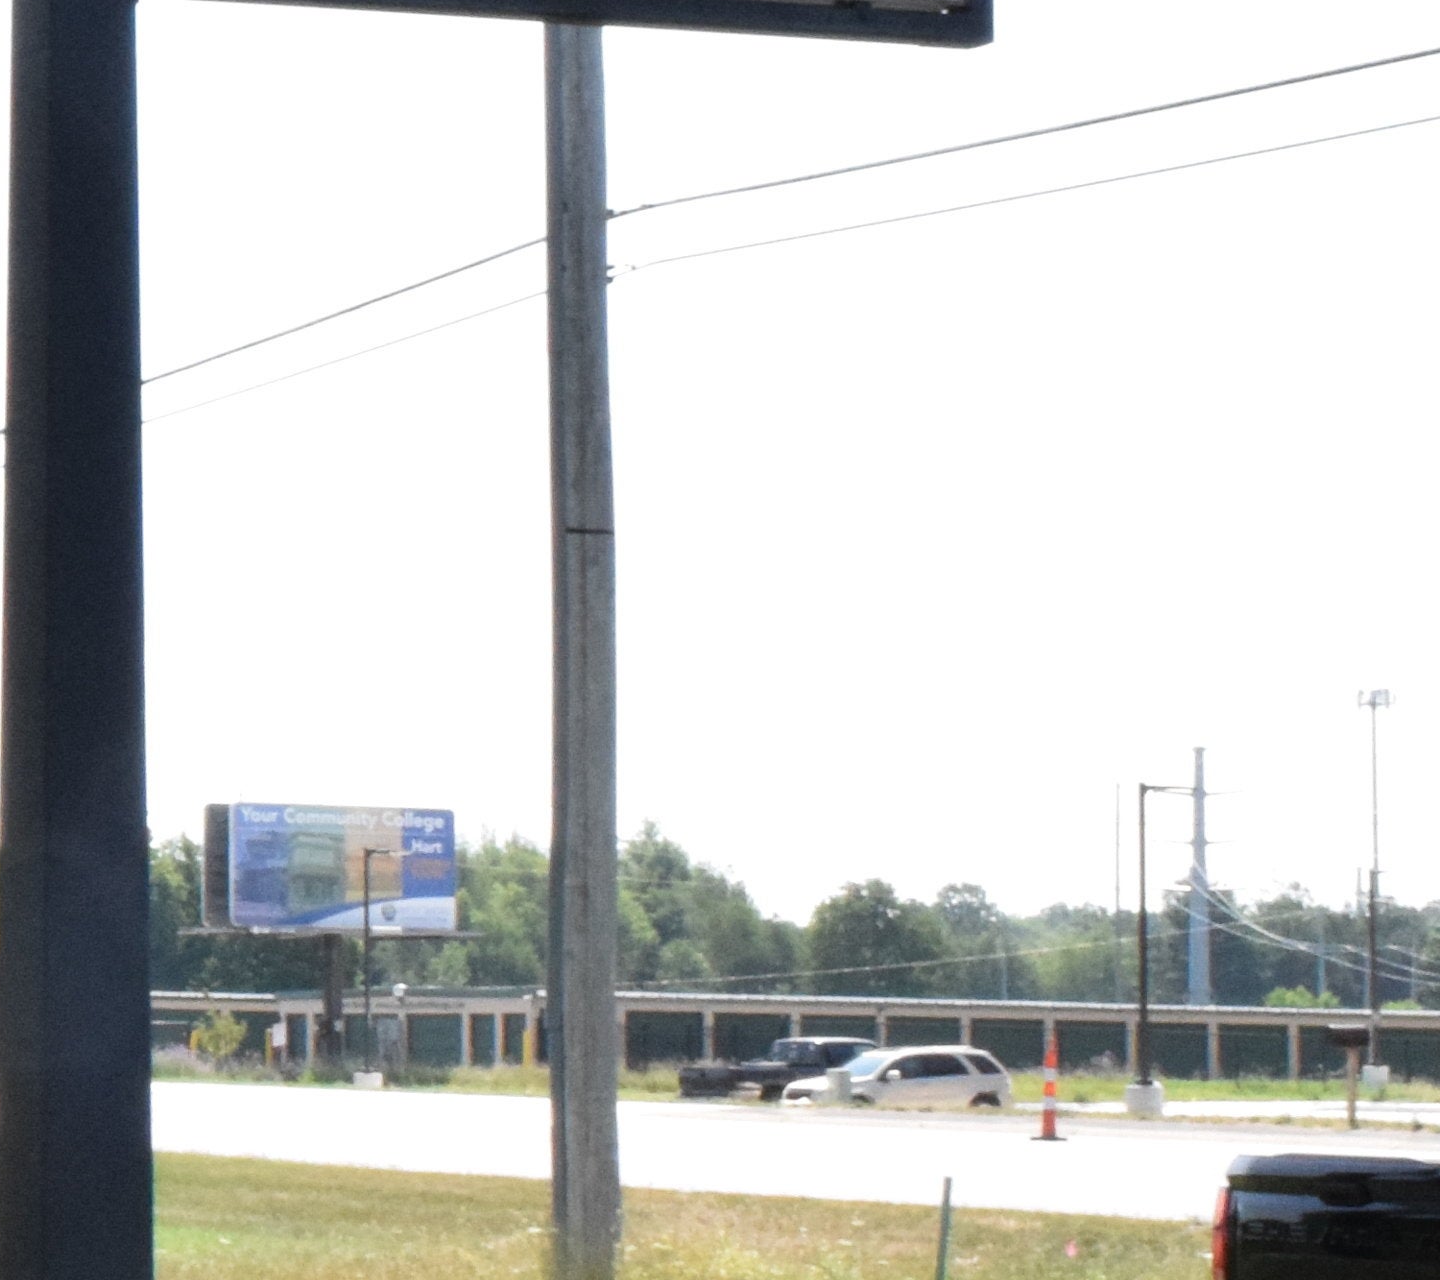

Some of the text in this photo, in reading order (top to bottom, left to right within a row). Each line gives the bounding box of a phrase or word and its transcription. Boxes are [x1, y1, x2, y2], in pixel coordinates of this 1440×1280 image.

[240, 806, 444, 832] Your Community College
